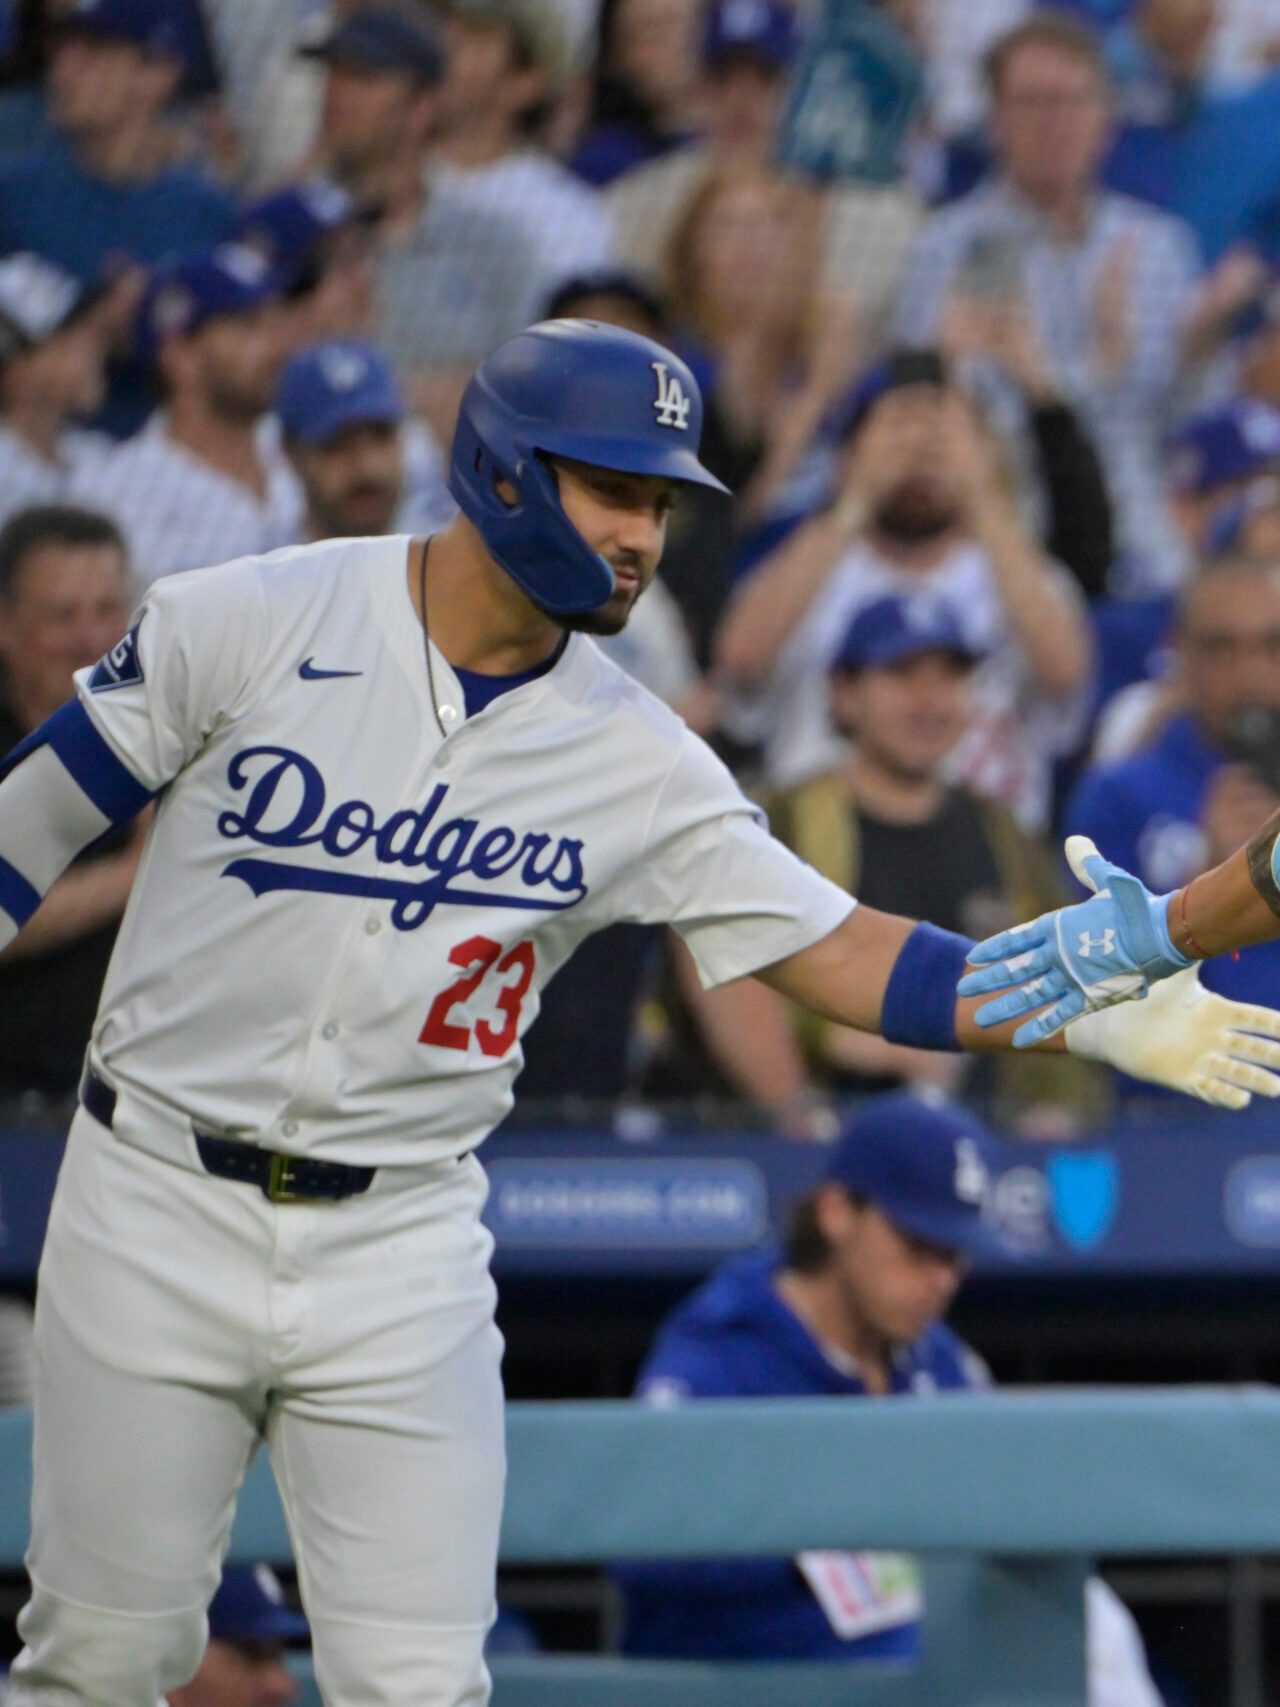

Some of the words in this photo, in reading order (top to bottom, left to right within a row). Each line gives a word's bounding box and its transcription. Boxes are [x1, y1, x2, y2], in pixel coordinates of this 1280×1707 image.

[651, 362, 690, 430] LA
[217, 745, 588, 931] Dodgers
[417, 935, 536, 1058] 23
